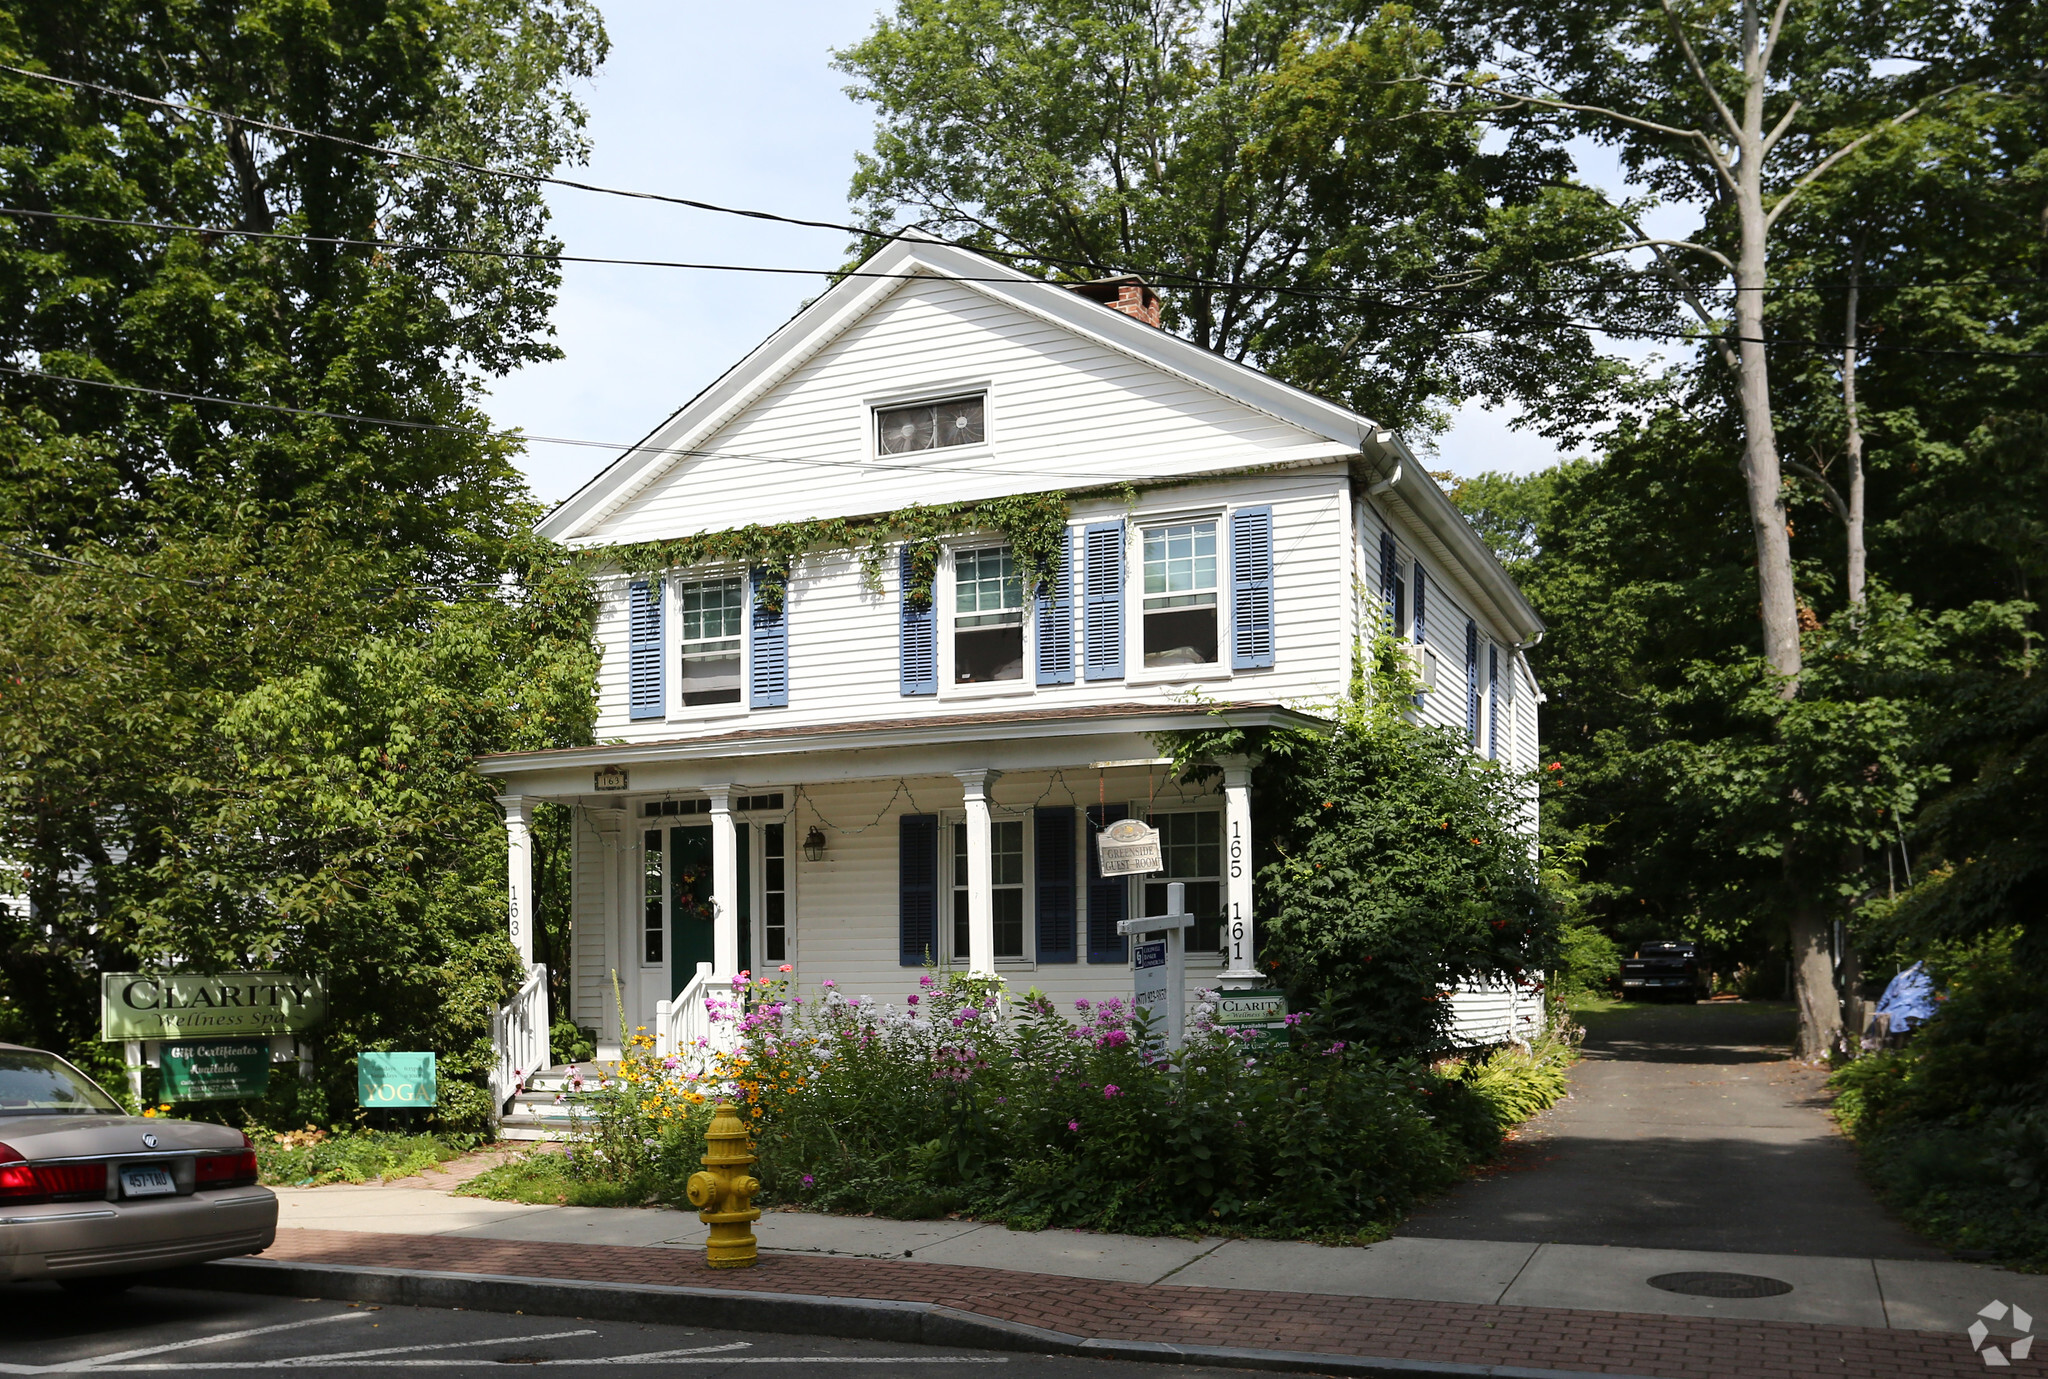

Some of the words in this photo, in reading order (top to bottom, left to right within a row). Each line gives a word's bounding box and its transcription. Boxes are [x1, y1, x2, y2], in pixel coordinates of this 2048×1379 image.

[603, 776, 619, 786] 163
[1107, 846, 1154, 859] GREENSIDE
[1231, 821, 1242, 878] 165
[1105, 859, 1130, 871] GUEST
[1135, 857, 1159, 869] ROOM
[511, 885, 519, 936] 163
[1232, 902, 1243, 960] 161
[122, 980, 312, 1011] CLARITY
[1222, 1000, 1282, 1012] CLARITY
[151, 1012, 244, 1029] Wellness
[250, 1011, 287, 1029] Spa
[171, 1046, 194, 1060] Gift
[197, 1045, 258, 1058] Certificates
[190, 1062, 239, 1075] Available
[365, 1083, 431, 1101] YOGA
